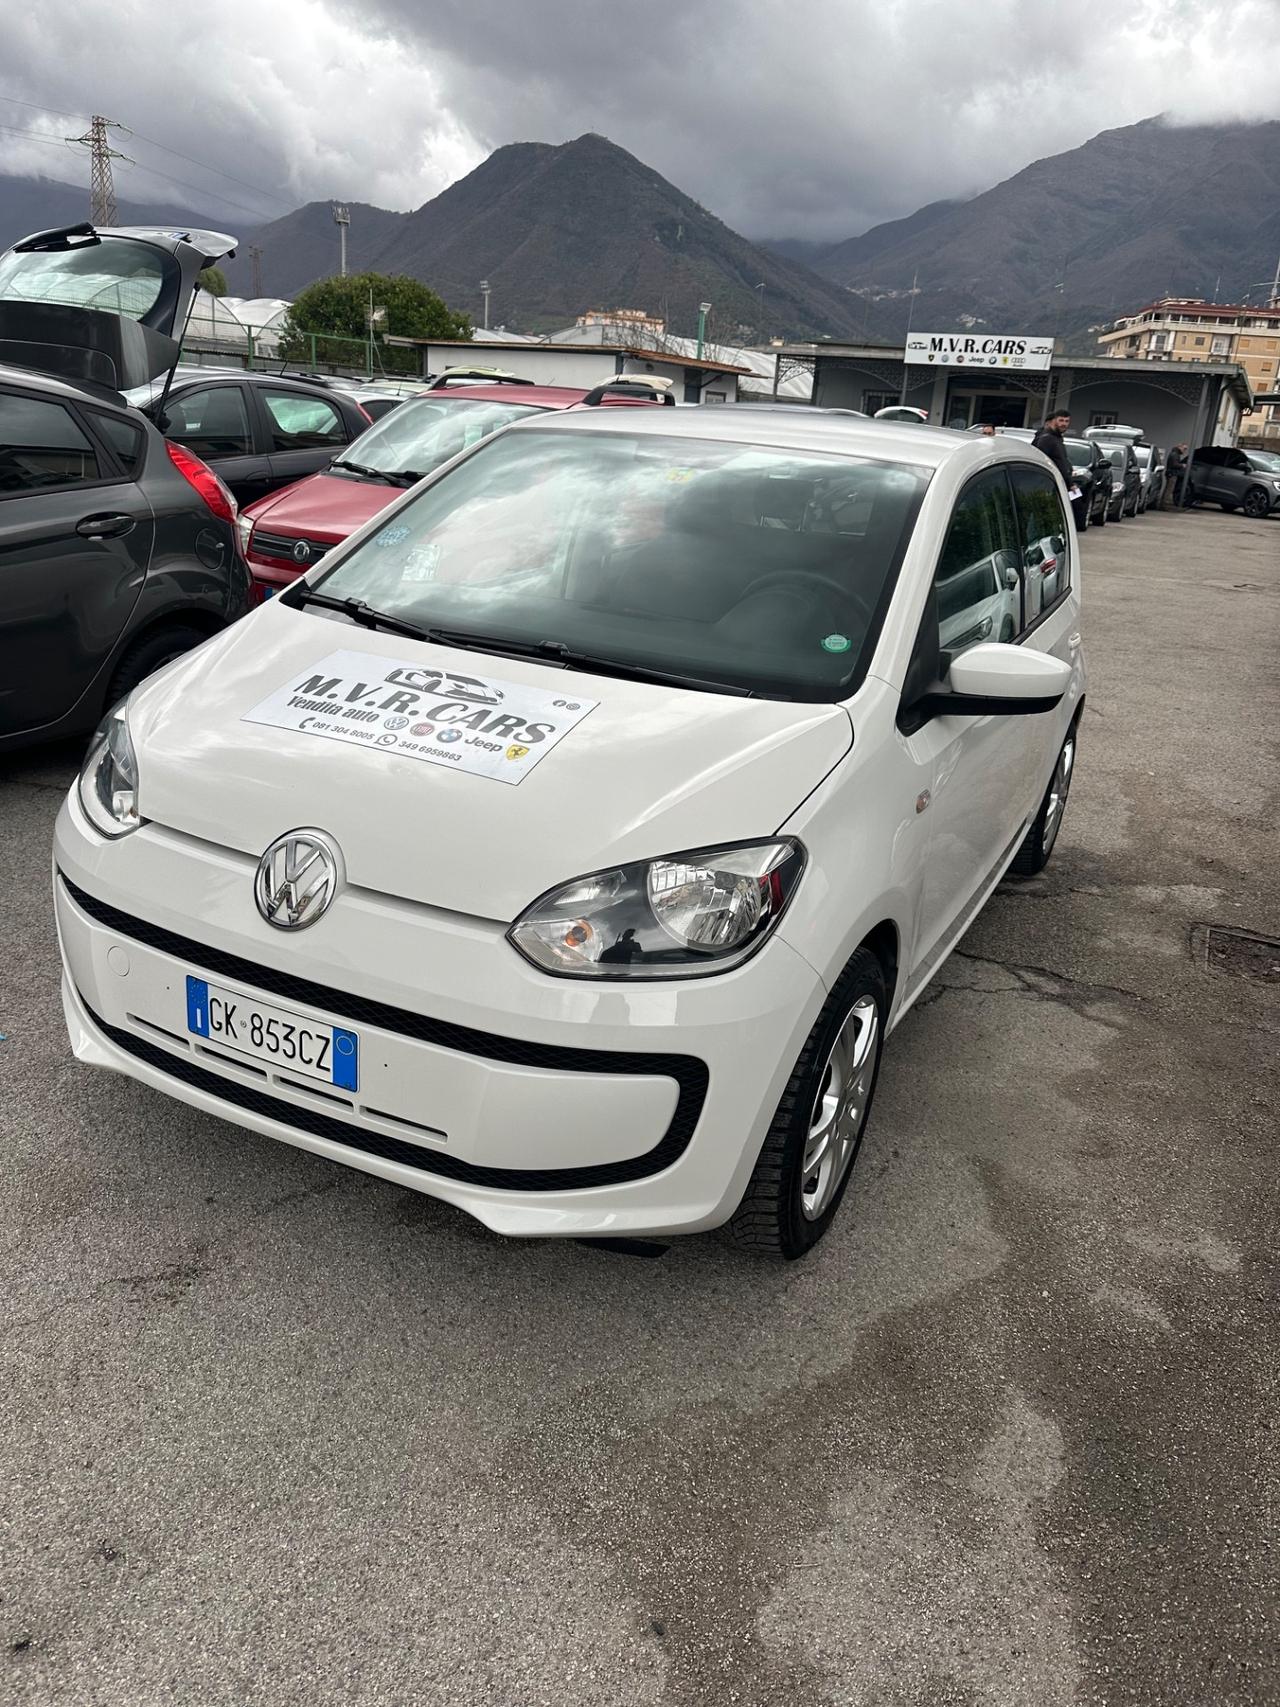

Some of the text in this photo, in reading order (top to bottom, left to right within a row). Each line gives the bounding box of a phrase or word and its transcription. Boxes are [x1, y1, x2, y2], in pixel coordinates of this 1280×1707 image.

[287, 695, 380, 723] Vendita auto
[312, 721, 375, 740] 081 304 8005
[398, 740, 419, 751] 349
[464, 736, 503, 752] Jeep
[209, 997, 331, 1073] GK 853CZ
